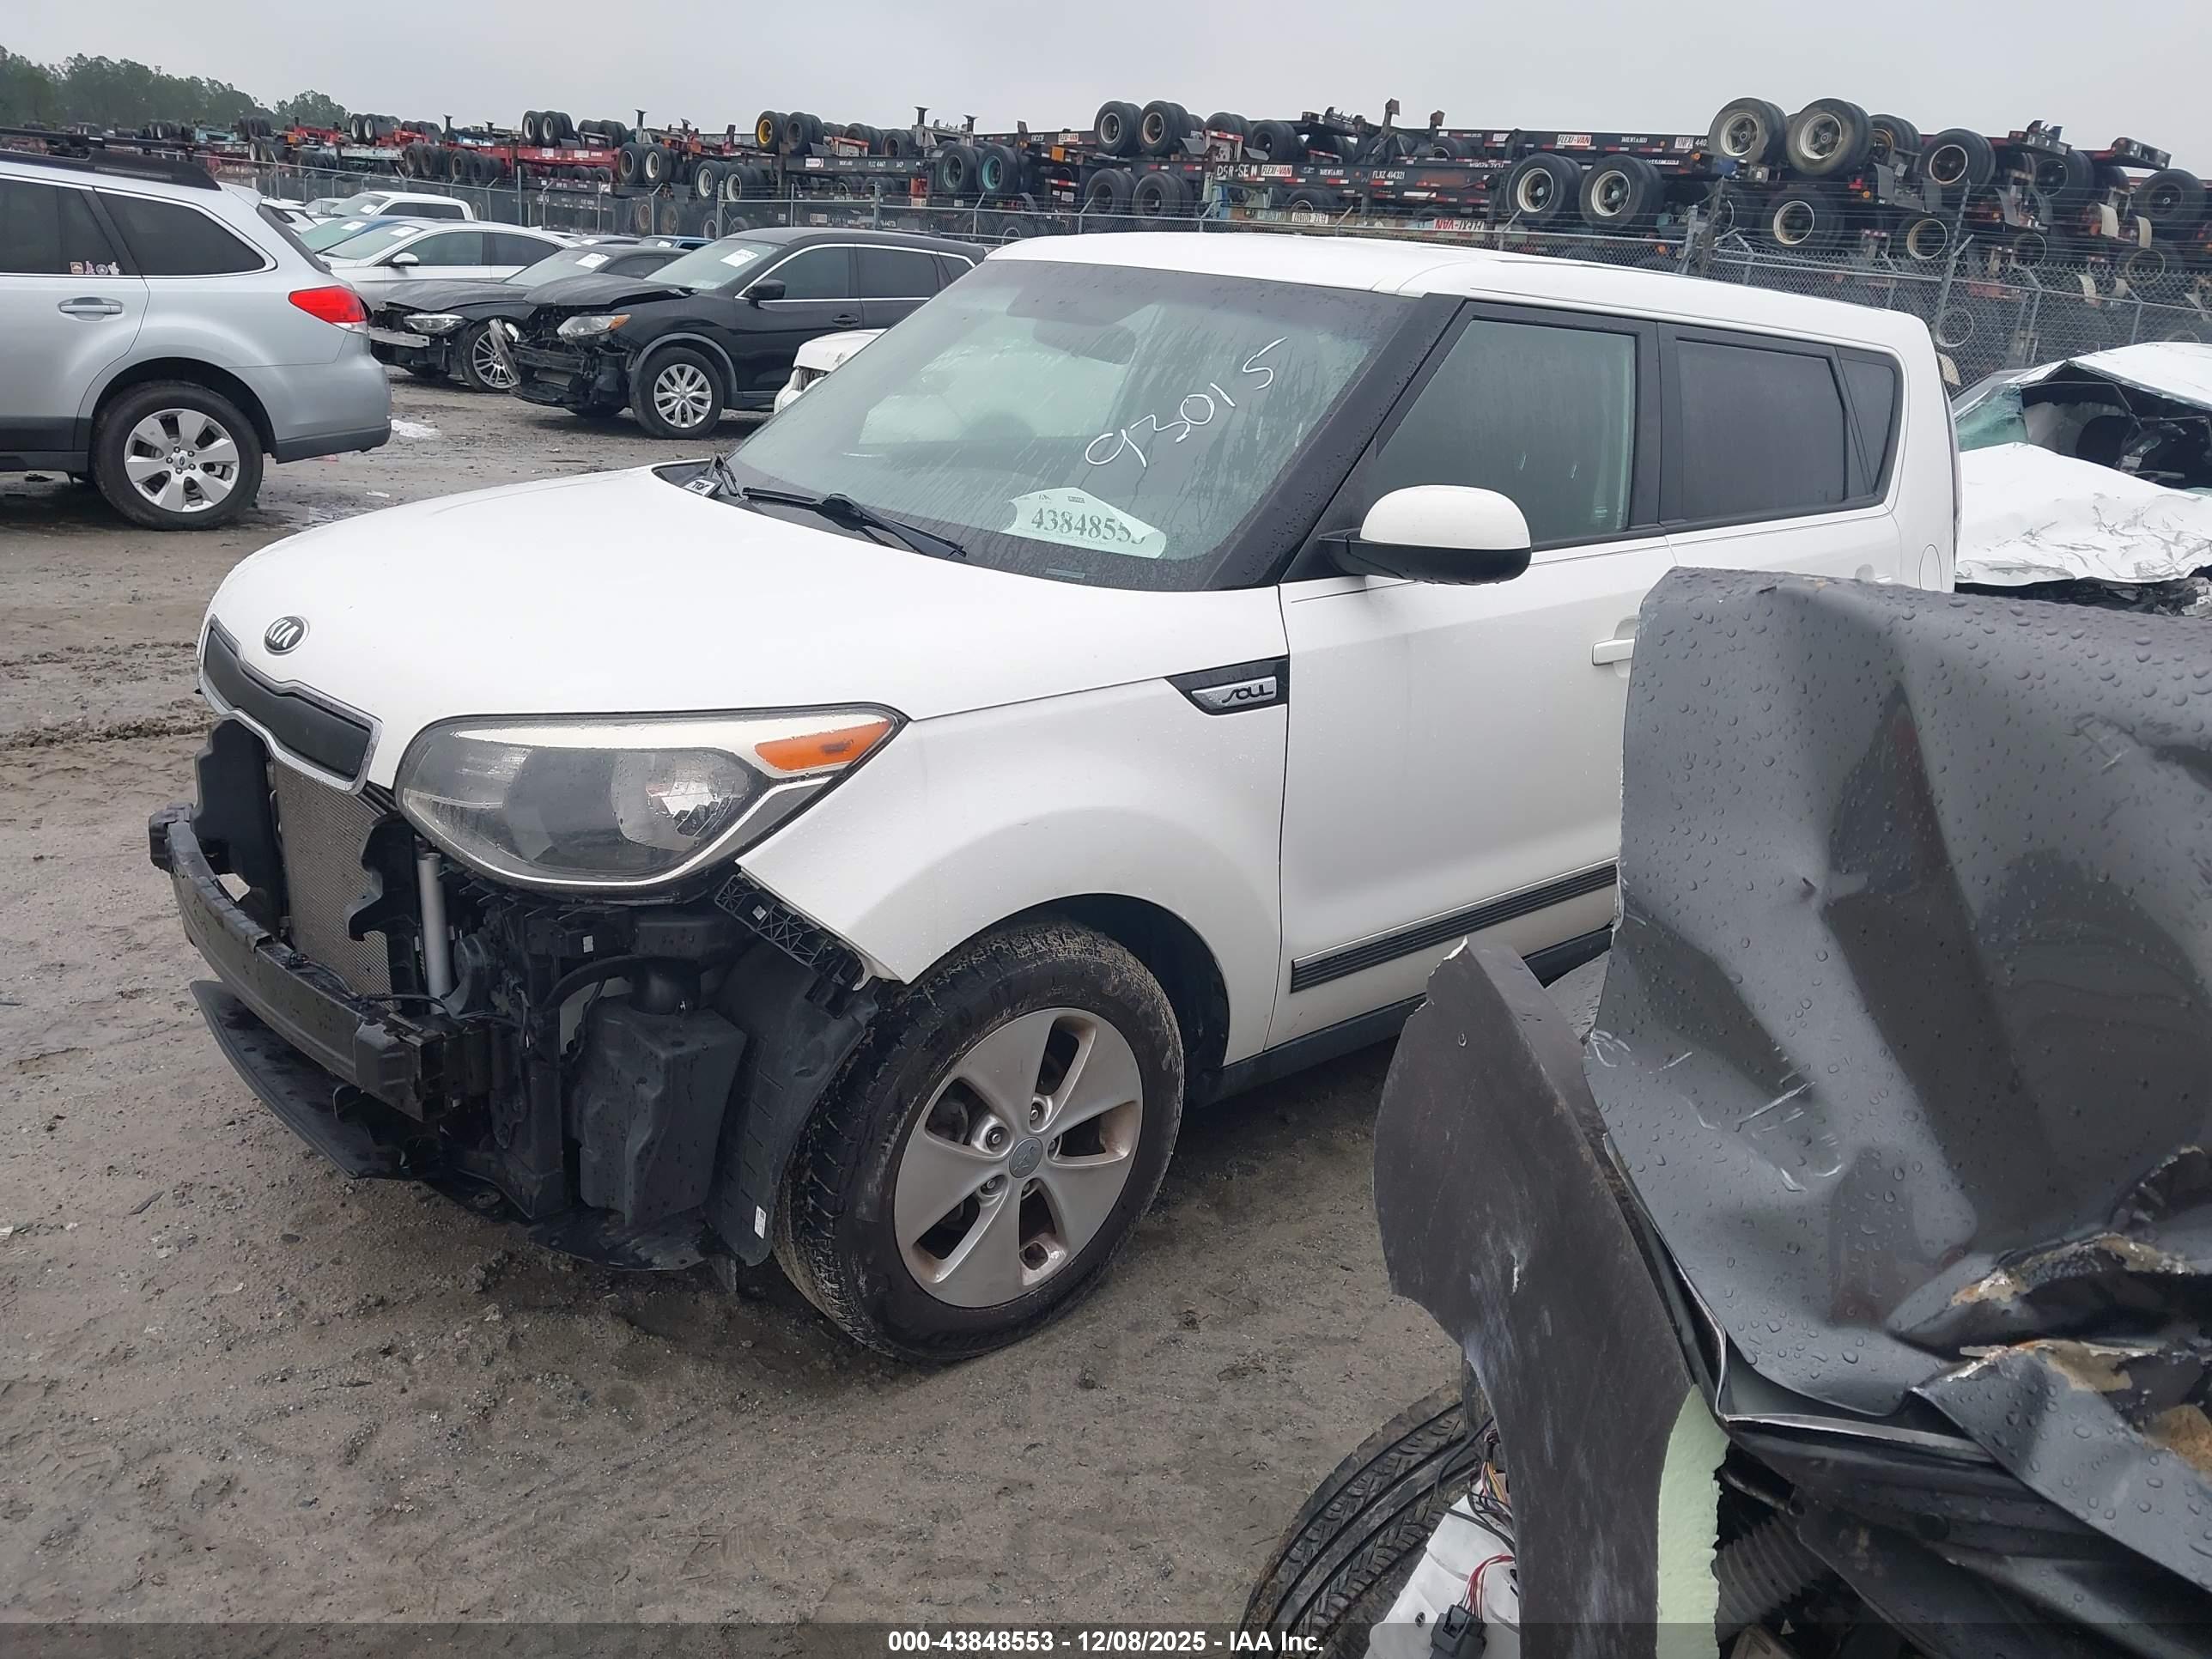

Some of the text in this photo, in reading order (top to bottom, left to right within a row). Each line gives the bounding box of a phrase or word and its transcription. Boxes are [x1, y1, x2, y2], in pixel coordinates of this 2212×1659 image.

[1558, 134, 1591, 145] FLEXI-VAN
[1261, 165, 1292, 175] FLEXI-VAN
[1435, 219, 1484, 231] FLEXI-VAN
[1030, 507, 1147, 545] 4384855
